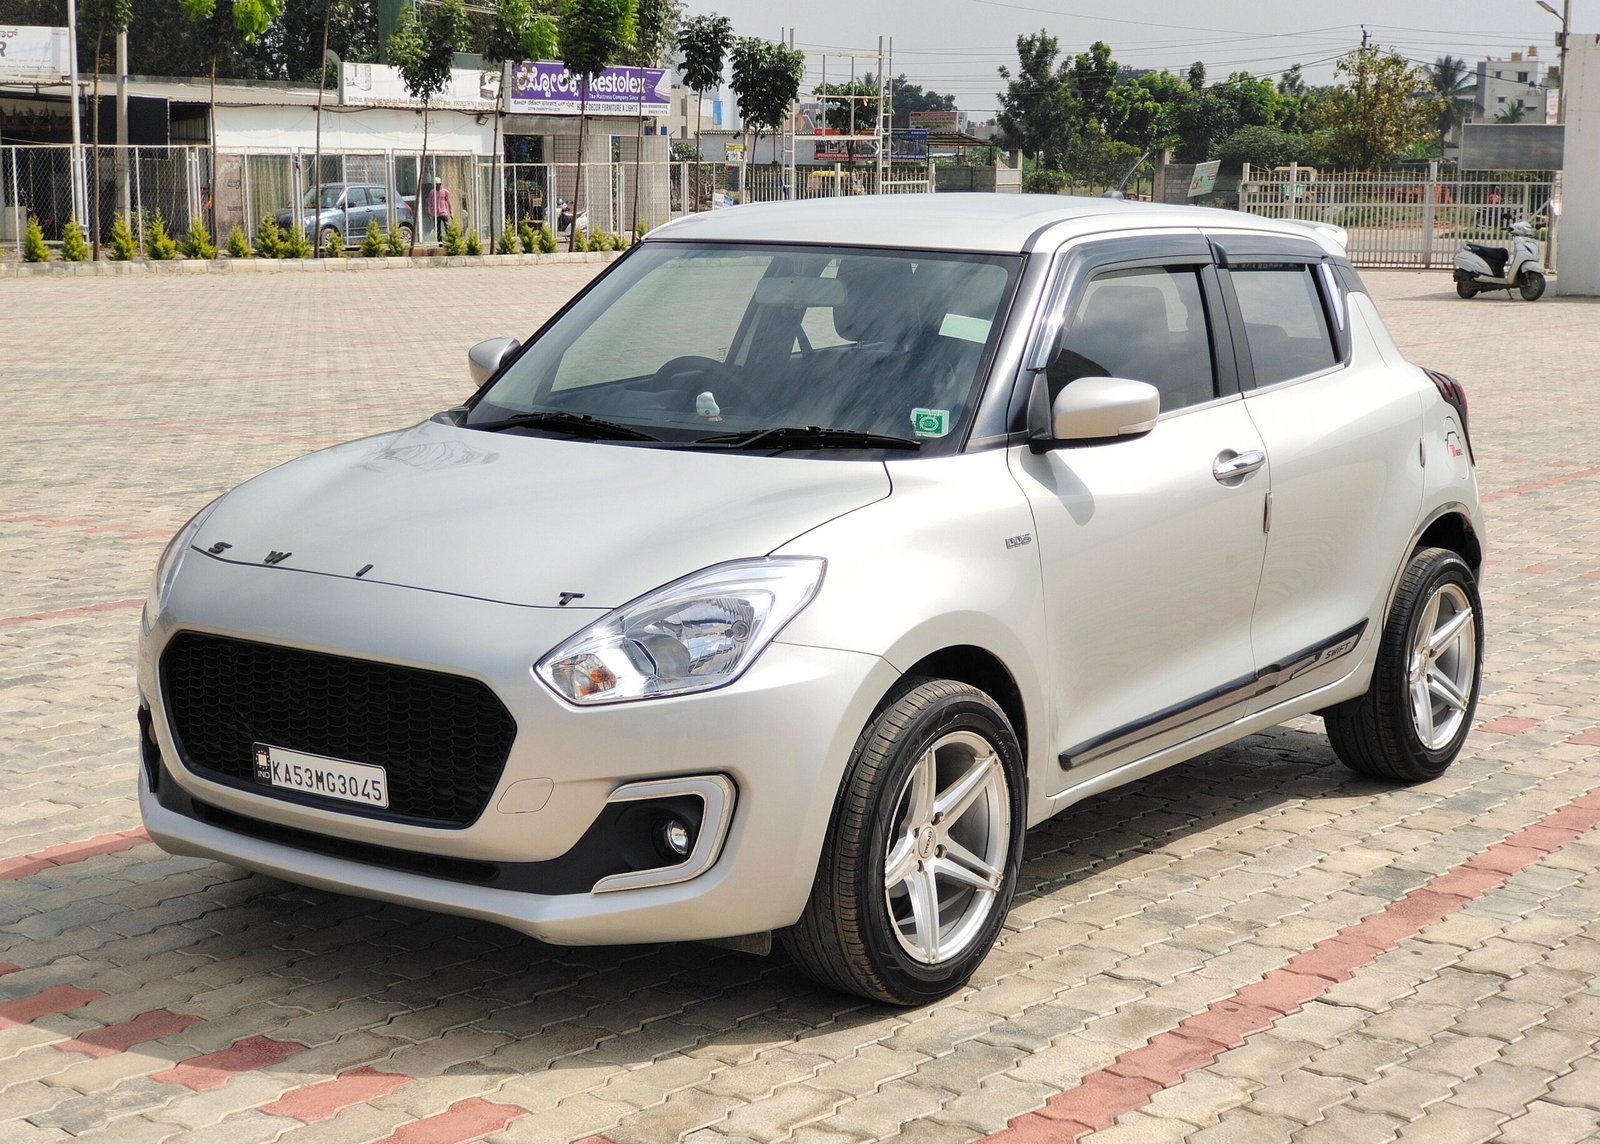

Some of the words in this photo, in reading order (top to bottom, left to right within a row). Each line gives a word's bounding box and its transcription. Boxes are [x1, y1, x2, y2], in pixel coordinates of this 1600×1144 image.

[588, 70, 646, 94] kestolex
[577, 103, 588, 111] HOE
[601, 104, 622, 112] FURNITURE
[1325, 642, 1351, 660] SWIFT
[257, 770, 270, 779] IND
[272, 760, 382, 801] KA53MG3045
